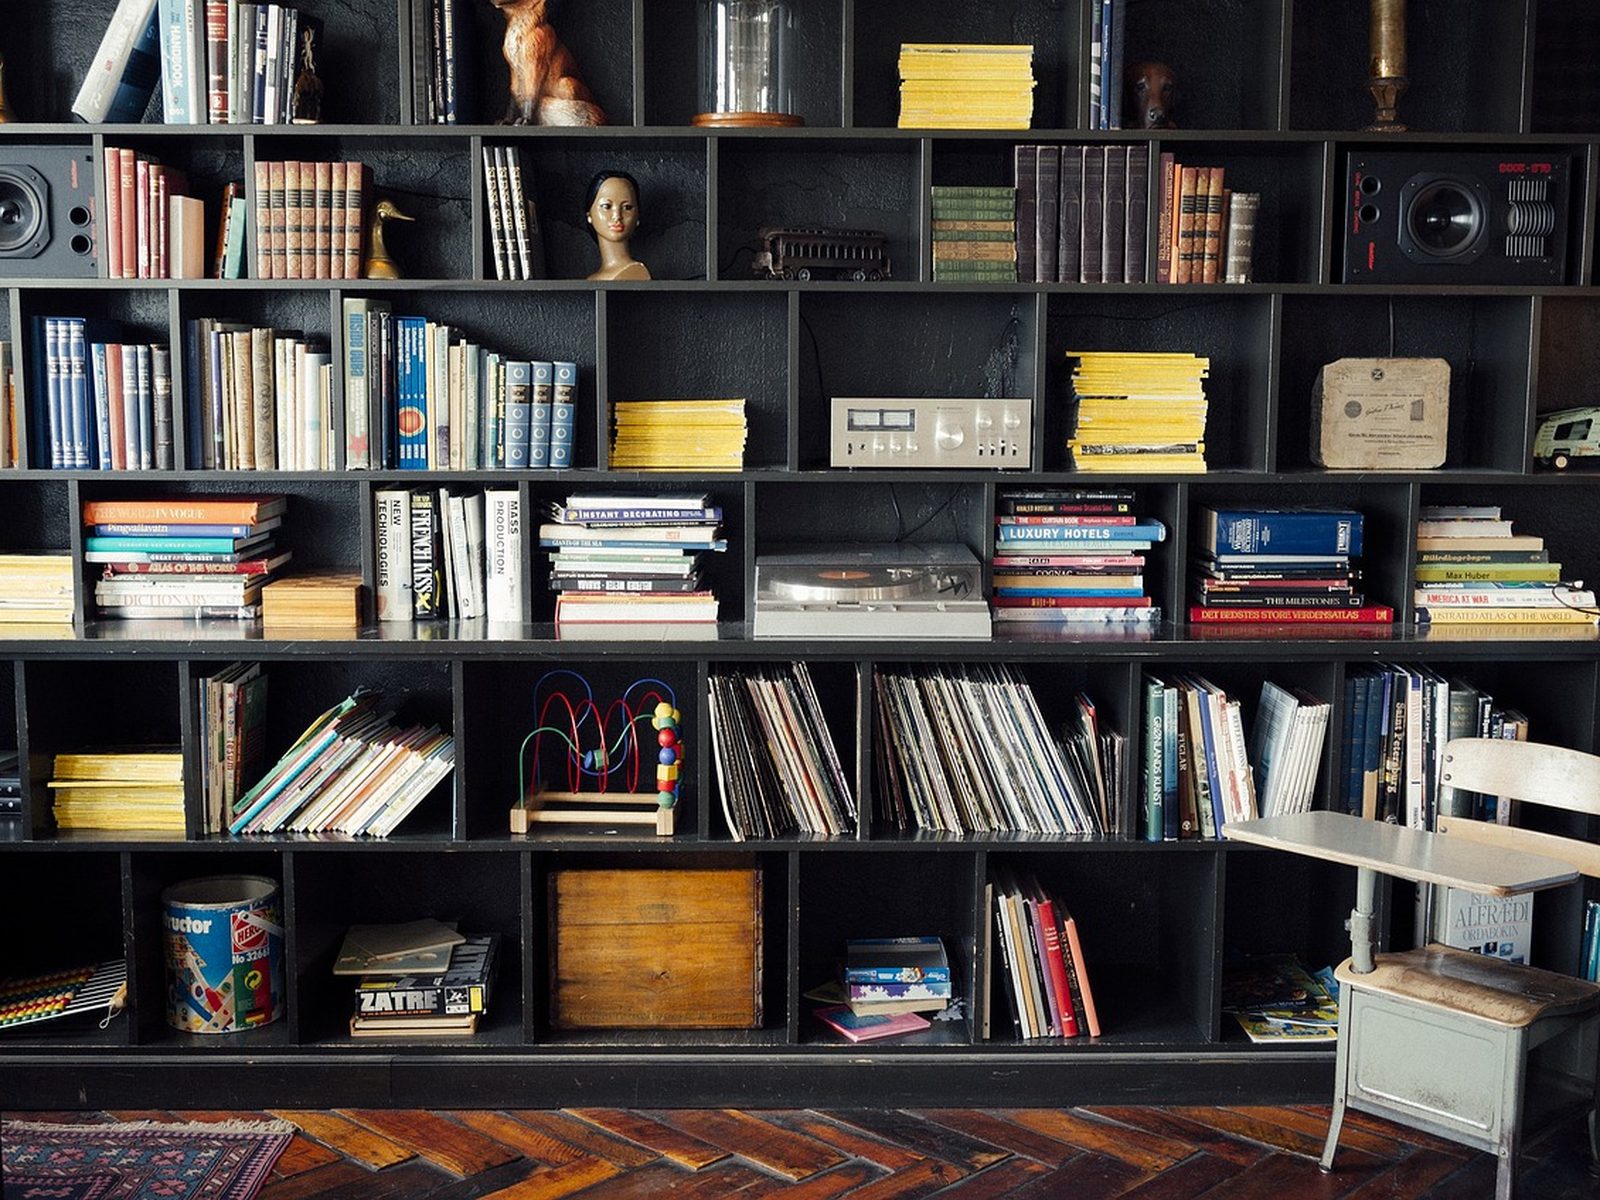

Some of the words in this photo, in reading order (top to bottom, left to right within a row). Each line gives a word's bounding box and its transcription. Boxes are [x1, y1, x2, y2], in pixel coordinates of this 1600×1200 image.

[170, 25, 184, 88] HANDBOOK
[156, 508, 168, 518] IN
[169, 508, 206, 519] VOGUE
[393, 500, 401, 526] NEW
[510, 500, 519, 535] MASS
[578, 510, 619, 519] INSTANT
[1019, 517, 1028, 525] THE
[1042, 516, 1063, 525] CURTAIN
[1064, 516, 1079, 525] BOOK
[378, 500, 389, 587] TECHNOLOGIES
[412, 509, 432, 560] FRENCH
[496, 500, 505, 575] PRODUCTION
[1010, 528, 1059, 539] LUXURY
[1064, 529, 1110, 539] HOTELS
[148, 563, 174, 572] ATLAS
[175, 563, 188, 572] OF
[189, 563, 204, 572] THE
[205, 563, 237, 572] WORLD
[413, 562, 433, 593] KISS
[1446, 571, 1463, 580] Max
[1465, 571, 1490, 580] Huber
[123, 594, 207, 606] DICTIONARY
[1264, 597, 1285, 605] THE
[1286, 598, 1340, 606] MILESTONES
[1427, 594, 1460, 604] AMERICA
[1461, 594, 1471, 603] AT
[1472, 595, 1489, 603] WAR
[1201, 610, 1220, 619] DET
[1220, 610, 1258, 619] BEDSTES
[1260, 610, 1291, 619] STORE
[1292, 610, 1359, 619] VERDENSATLAS
[1479, 612, 1505, 620] ATLAS
[1522, 612, 1538, 620] THE
[1540, 612, 1572, 620] WORLD
[1394, 702, 1405, 731] Saint
[1152, 715, 1162, 774] GRØNLANDS
[1177, 732, 1187, 771] FUGLAR
[1231, 714, 1248, 769] REFLECTIONS
[1387, 733, 1404, 794] Petersburg
[1152, 776, 1162, 808] KUNST
[232, 954, 245, 965] No
[360, 990, 438, 1012] ZATRE
